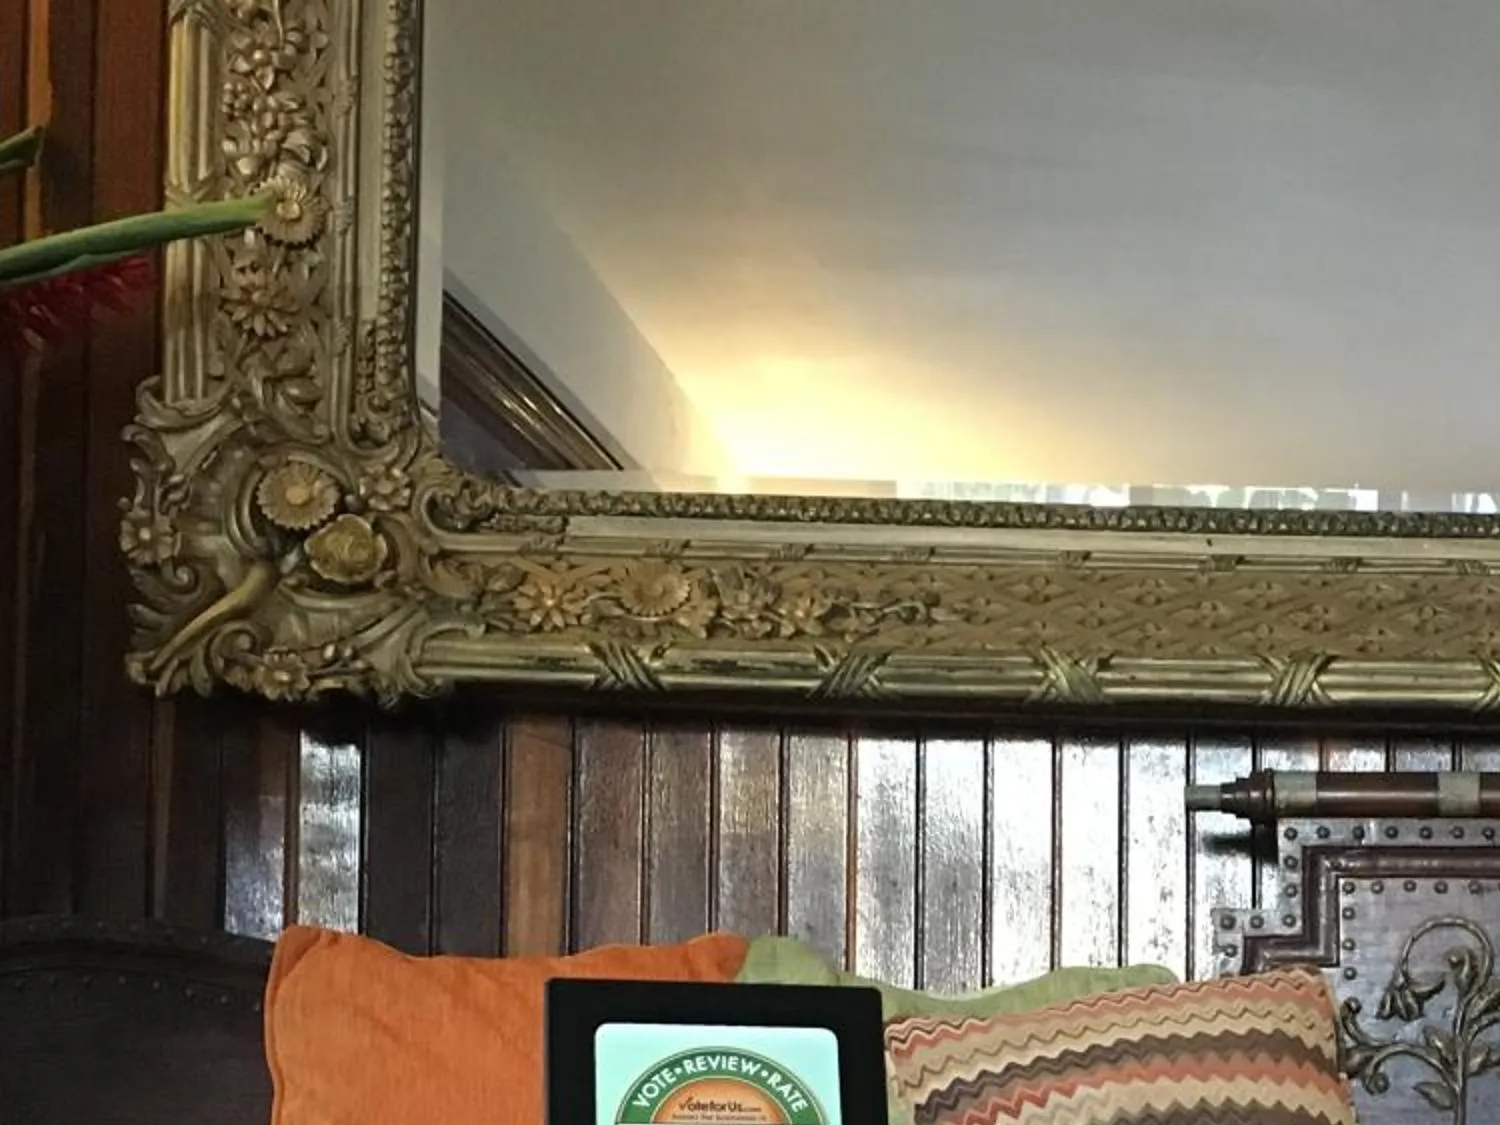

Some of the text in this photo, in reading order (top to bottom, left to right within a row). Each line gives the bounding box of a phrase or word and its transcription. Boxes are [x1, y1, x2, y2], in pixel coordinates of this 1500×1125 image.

[633, 1055, 809, 1112] VOTE REVIEW RATE
